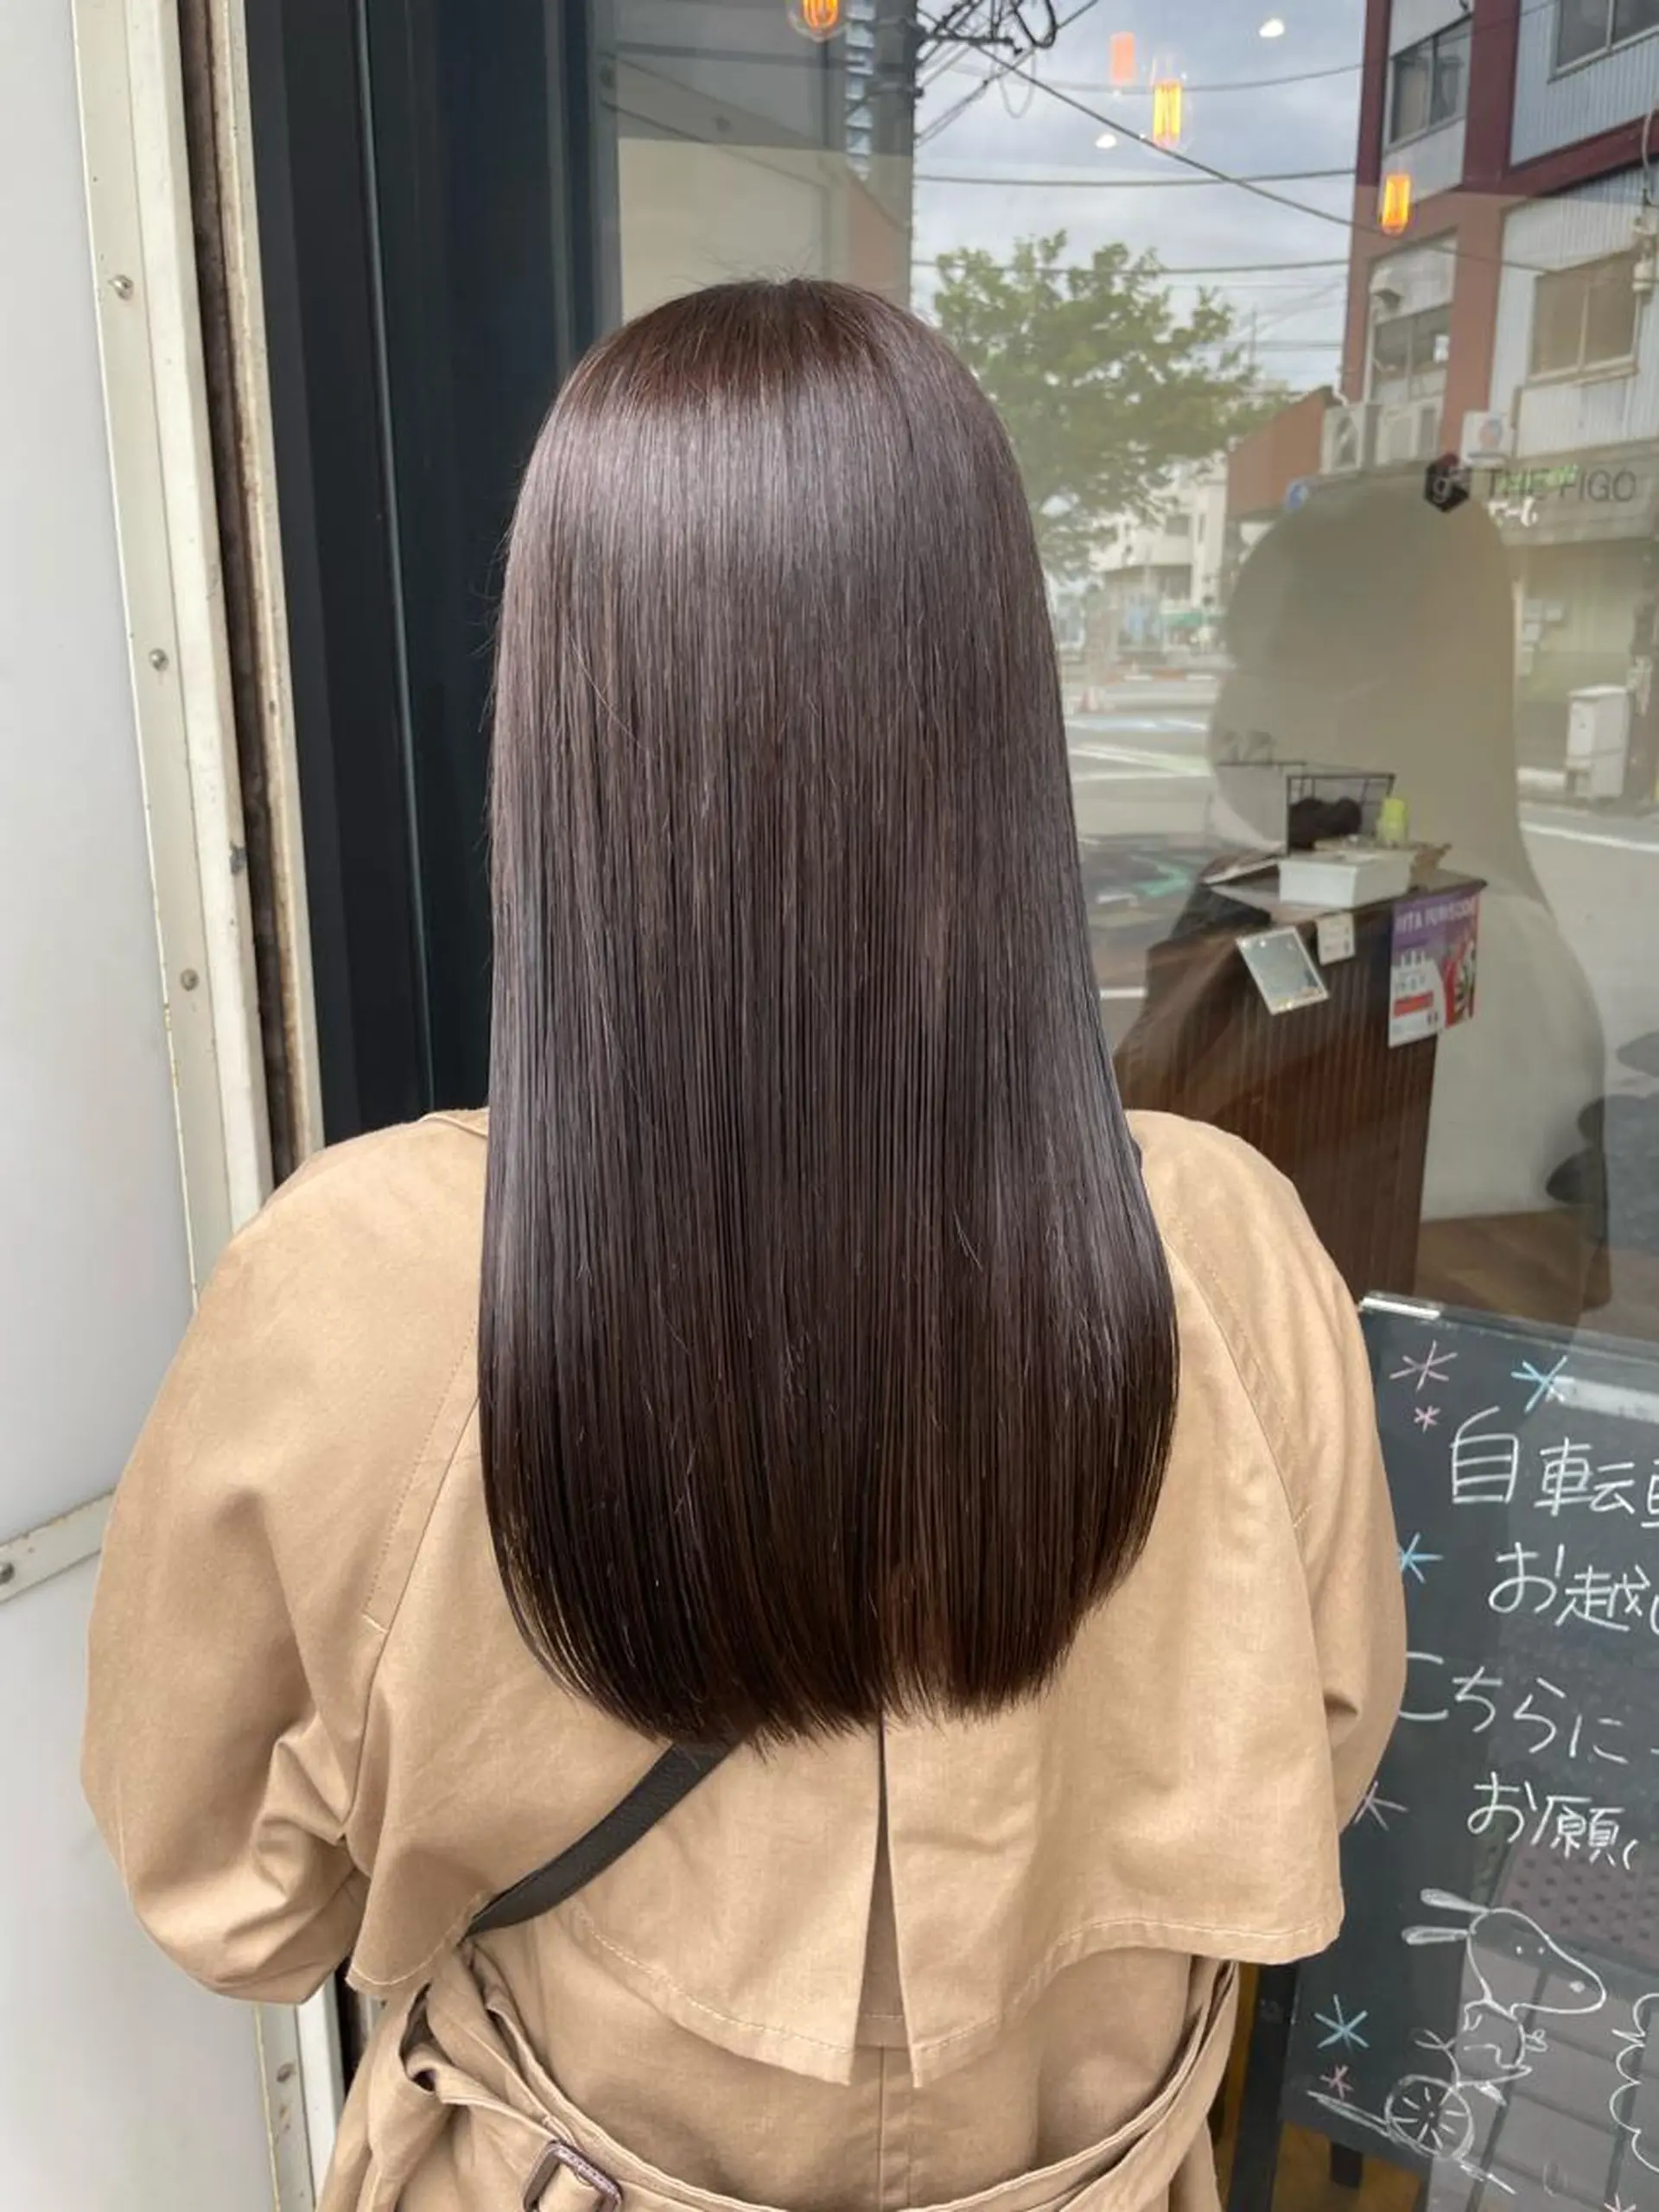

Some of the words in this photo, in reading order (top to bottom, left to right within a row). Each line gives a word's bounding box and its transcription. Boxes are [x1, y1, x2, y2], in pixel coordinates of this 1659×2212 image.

[1489, 1542, 1659, 1636] お越
[1399, 1651, 1659, 1764] こちらに
